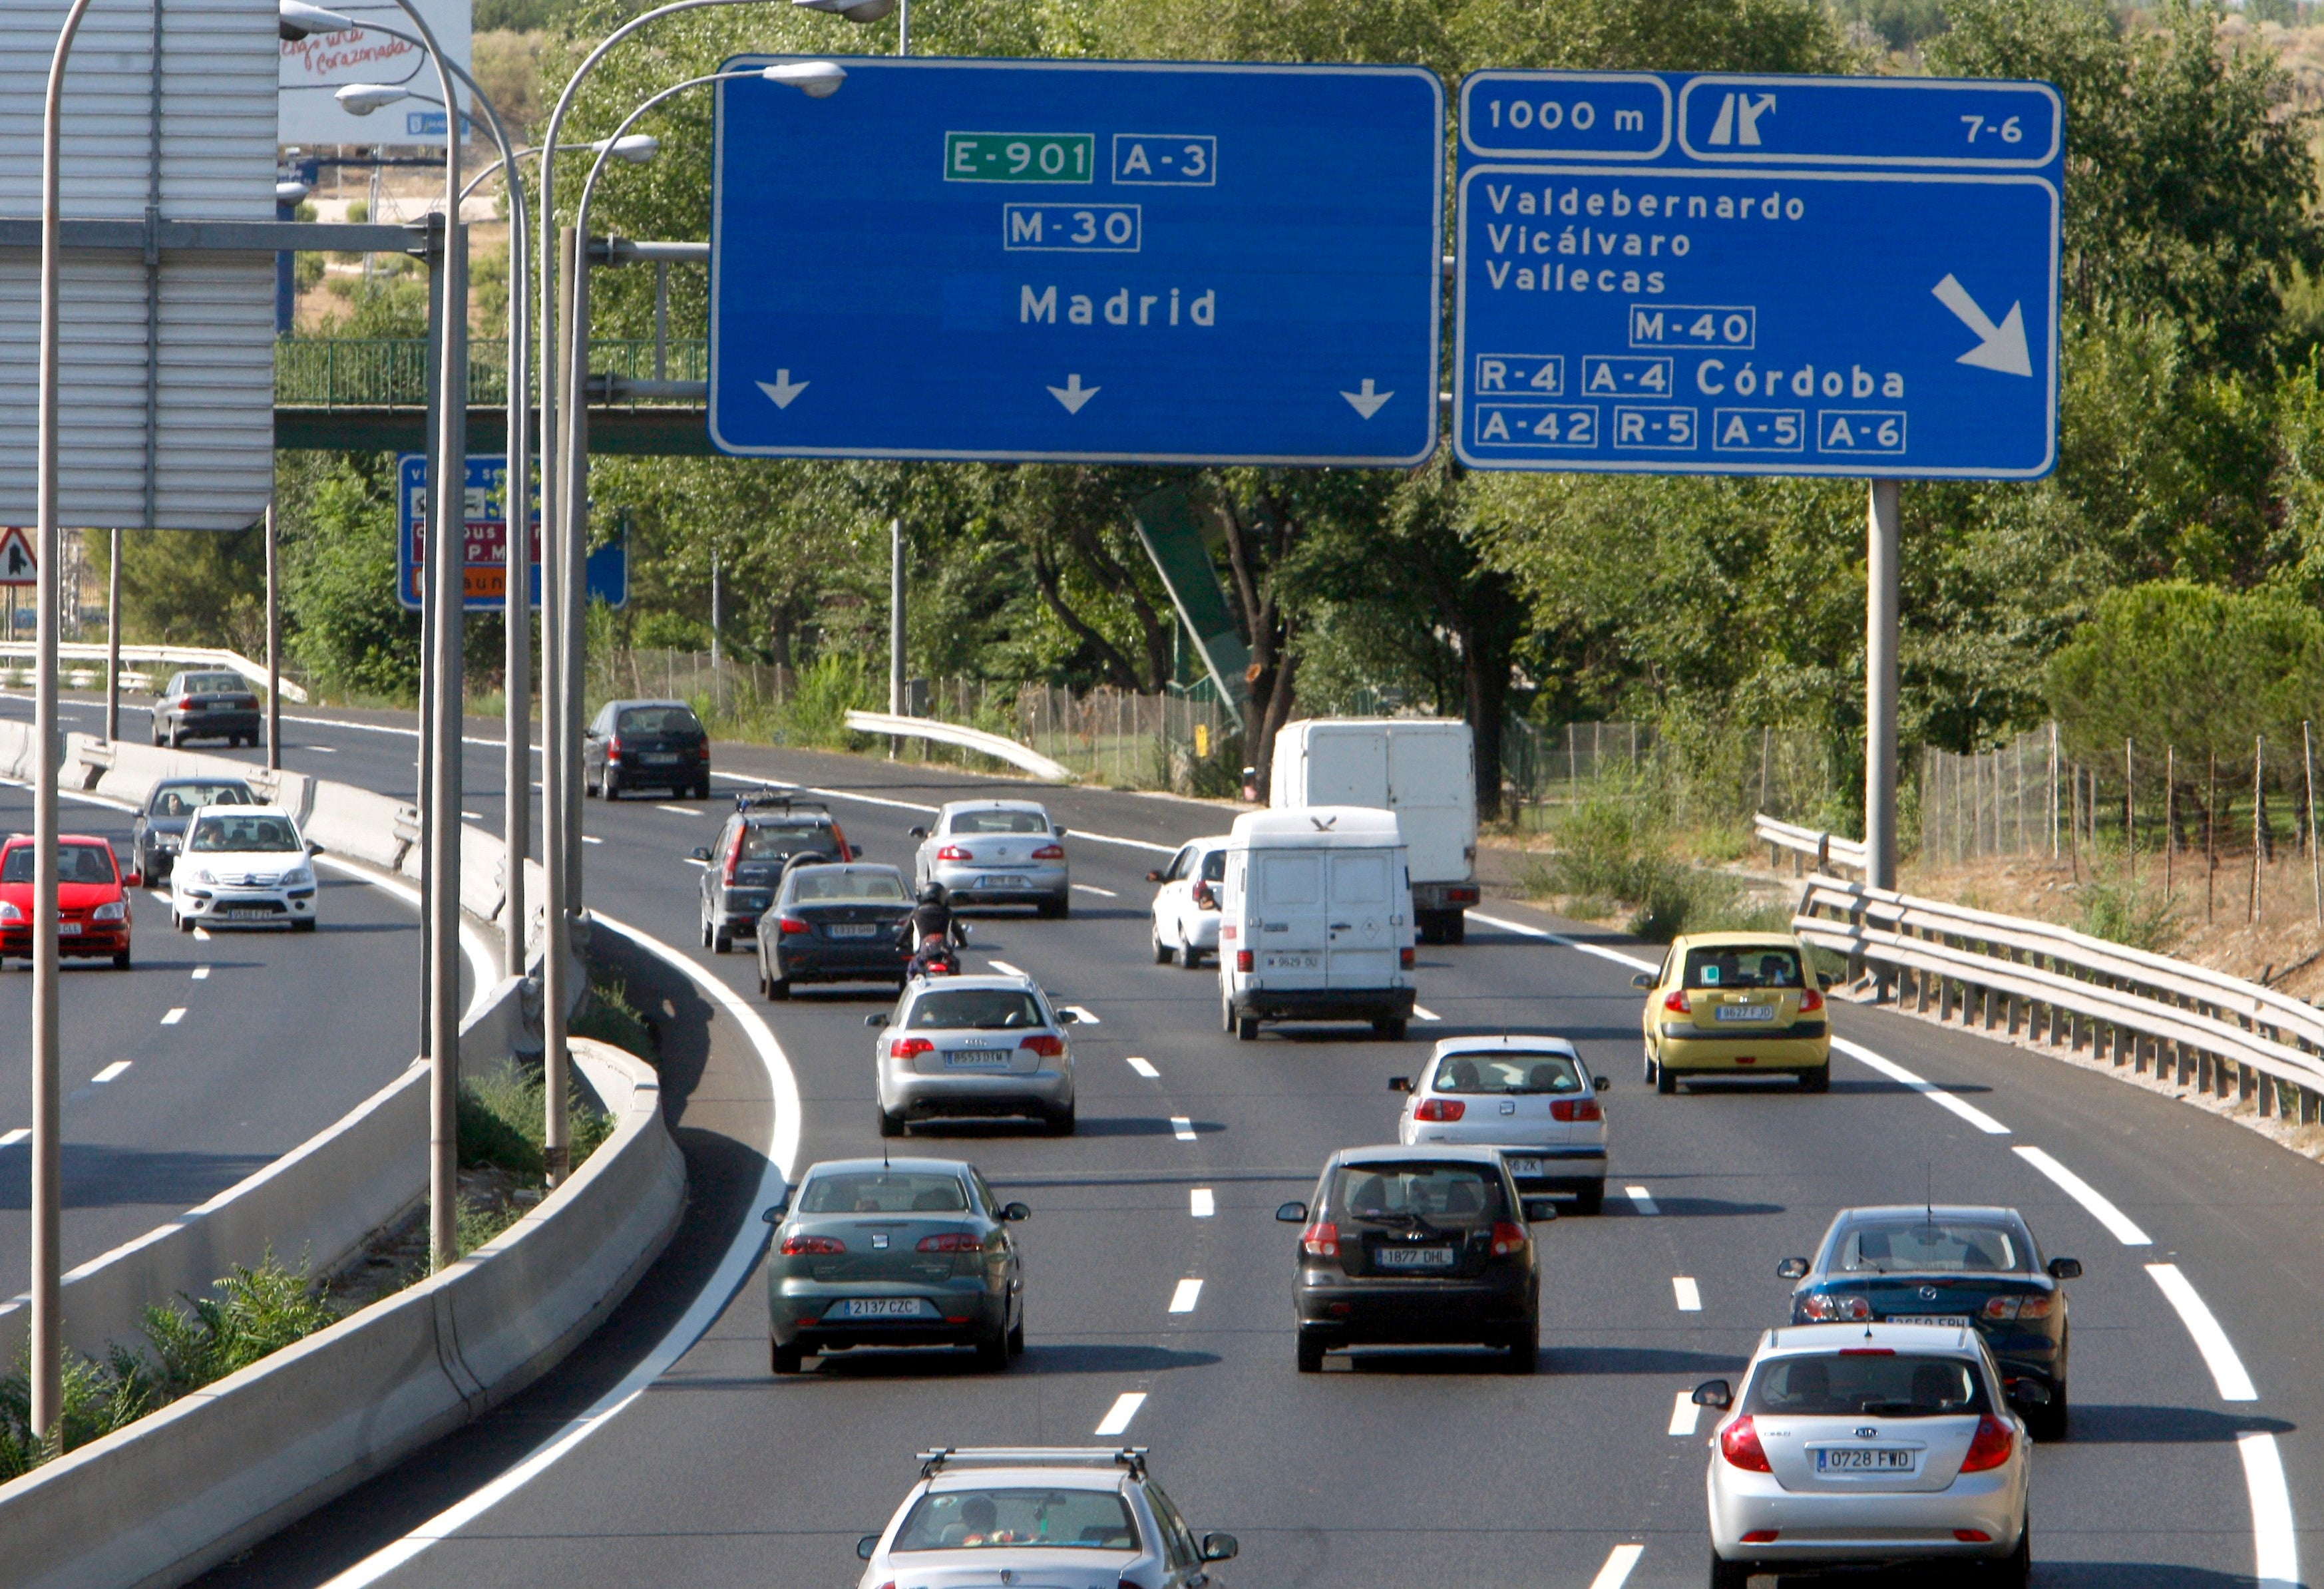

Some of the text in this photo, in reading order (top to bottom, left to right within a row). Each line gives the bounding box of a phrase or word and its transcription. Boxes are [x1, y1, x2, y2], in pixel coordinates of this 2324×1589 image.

[1489, 100, 1644, 132] 1000 m
[1960, 115, 2023, 143] 7-6
[954, 142, 1207, 176] E-901 A-3
[1486, 184, 1805, 221] Valdebernardo
[1011, 211, 1132, 244] M-30
[1487, 224, 1690, 257] Vicálvaro
[1485, 260, 1665, 294] Vallecas
[1020, 284, 1215, 326] Madrid
[1635, 311, 1748, 343] M-40
[1481, 359, 1904, 398] R-4 A-4 Córdoba
[1482, 411, 1899, 447] A-42 R-5 A-5 A-6
[1523, 1158, 1537, 1171] ZK
[1388, 1250, 1446, 1263] 1877 DHL
[853, 1300, 913, 1314] 2137 CZC
[1832, 1450, 1909, 1468] 0728 FWD
